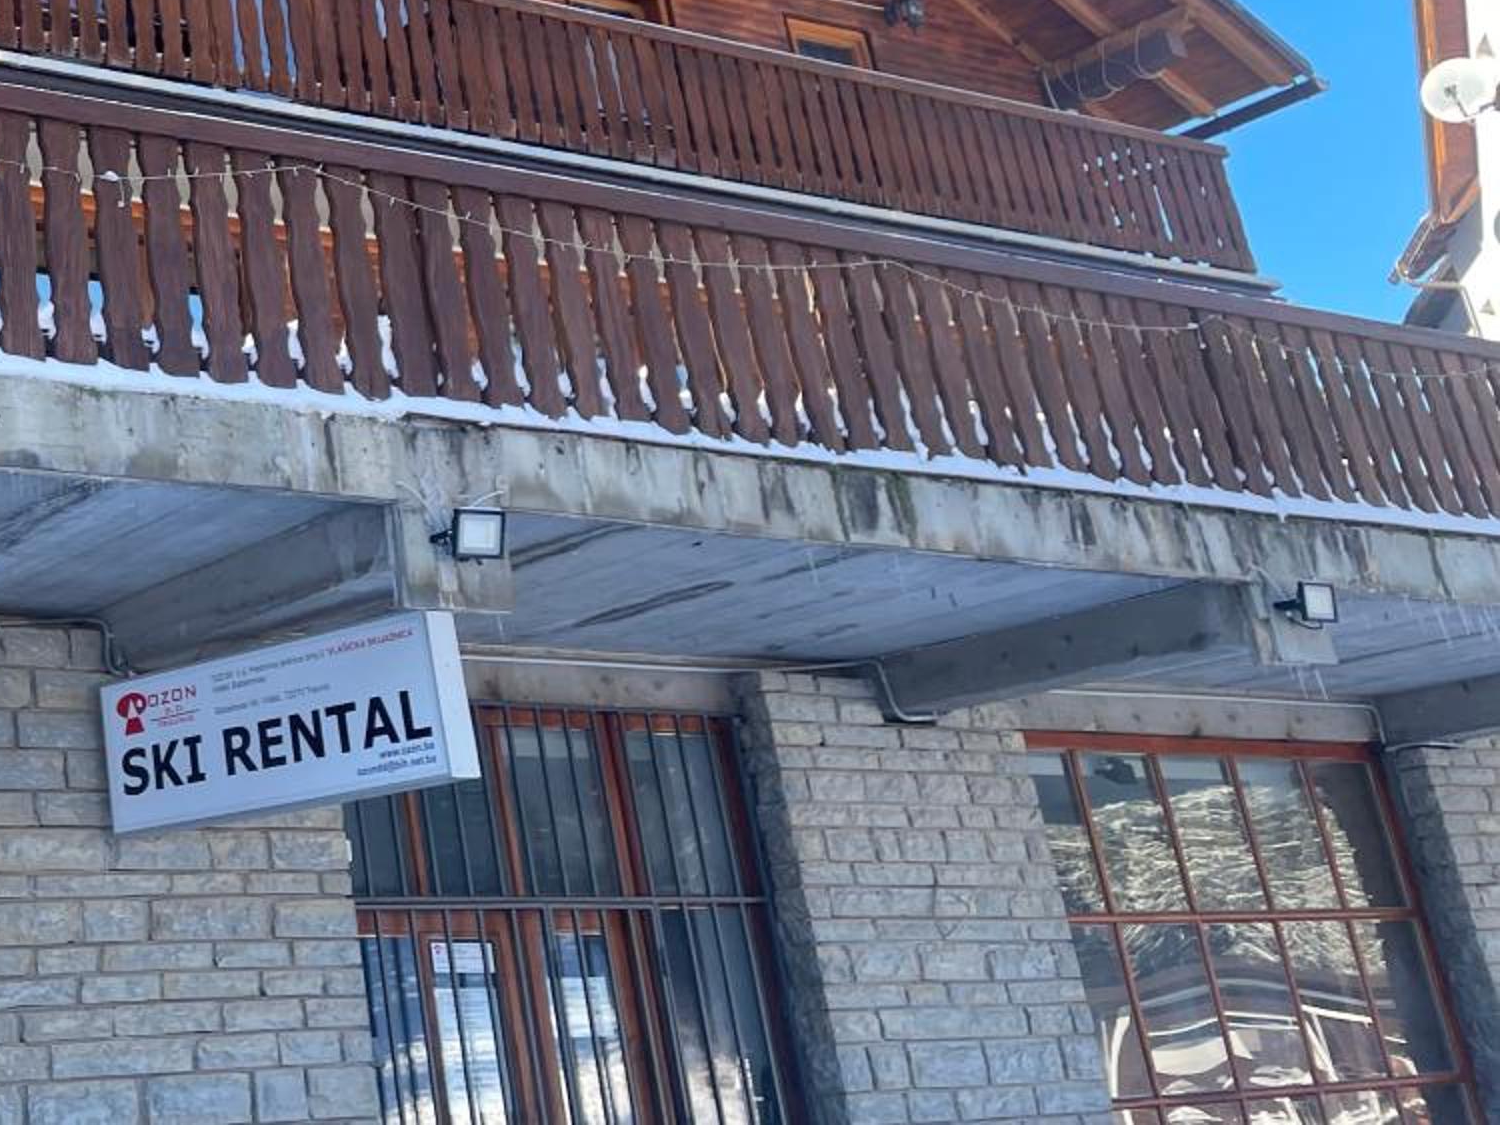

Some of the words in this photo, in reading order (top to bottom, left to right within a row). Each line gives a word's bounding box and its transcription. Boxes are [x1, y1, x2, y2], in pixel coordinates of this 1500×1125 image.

[148, 684, 198, 707] OZON
[121, 733, 206, 795] SKI
[221, 690, 434, 776] RENTAL
